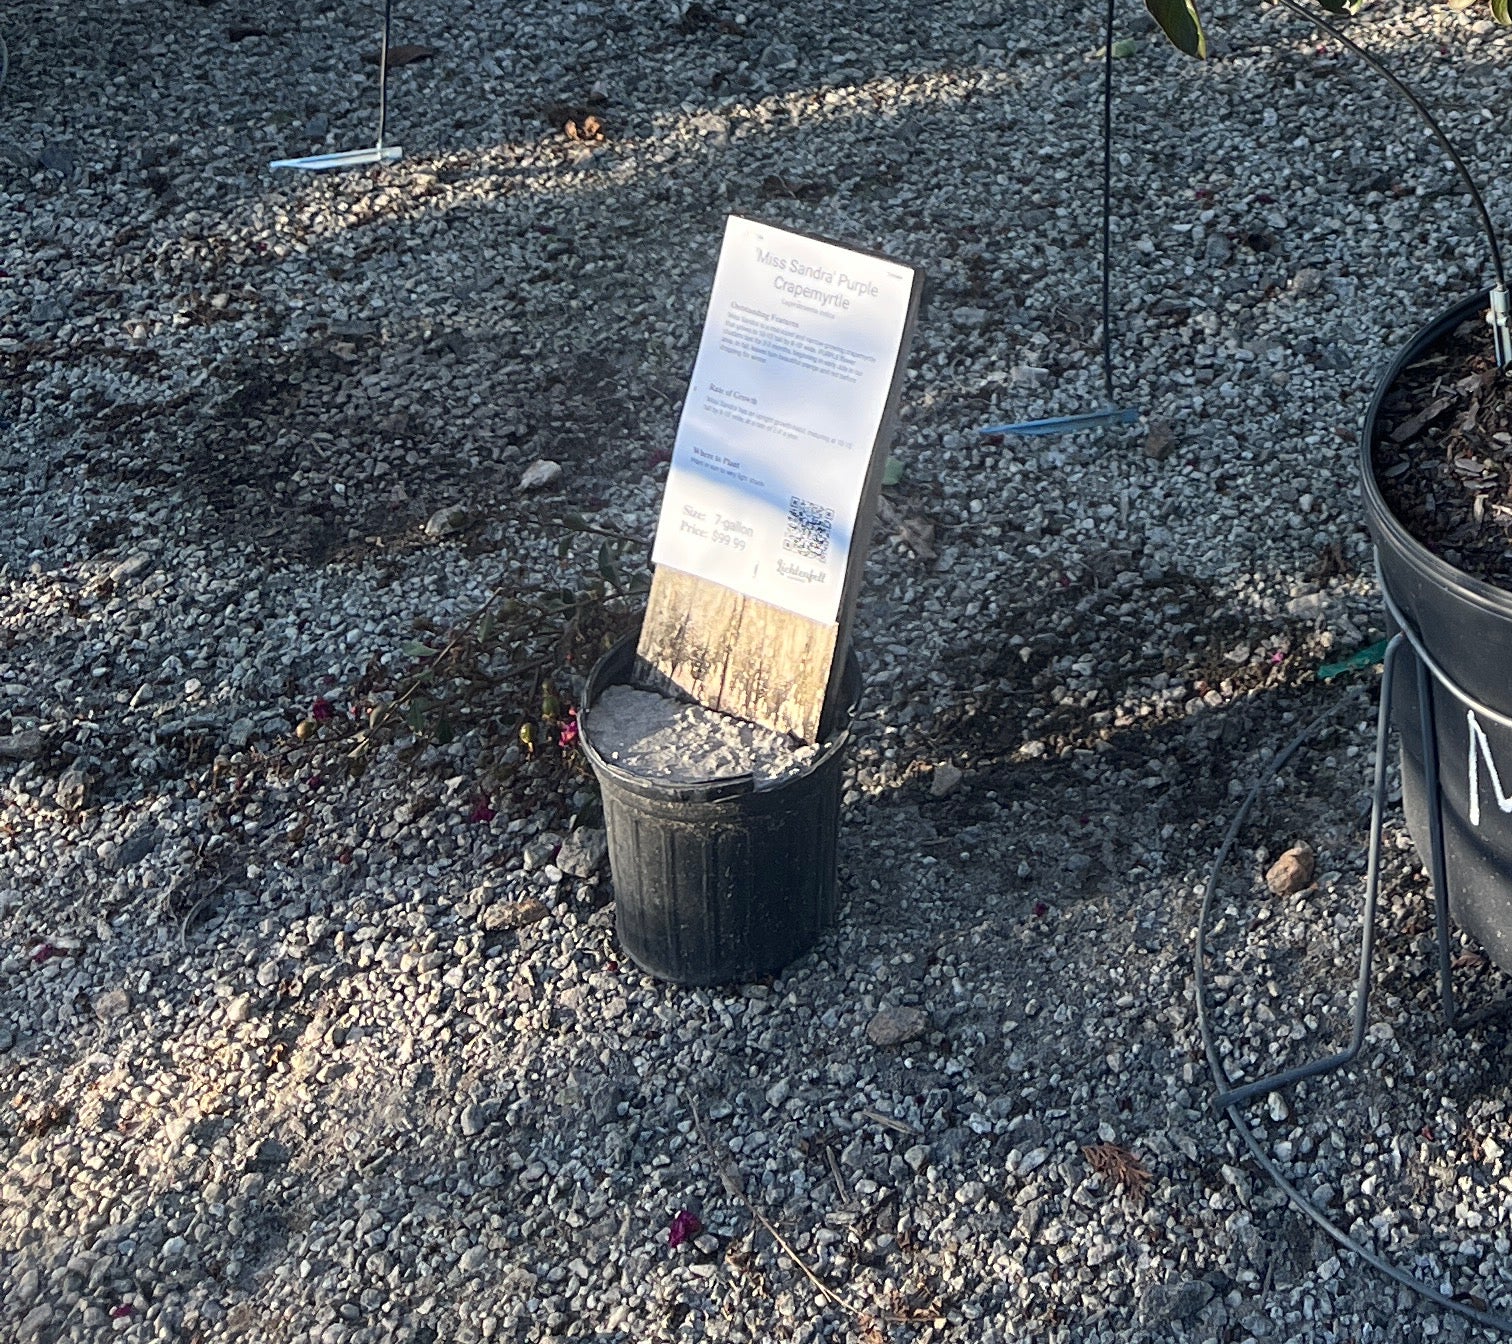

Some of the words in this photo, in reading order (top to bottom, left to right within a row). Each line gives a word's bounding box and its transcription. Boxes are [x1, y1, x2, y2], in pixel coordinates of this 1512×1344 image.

[774, 275, 850, 310] Crapemyrtle
[789, 259, 836, 284] Sandra'
[837, 273, 879, 297] Purple
[715, 513, 754, 537] 7-gallon
